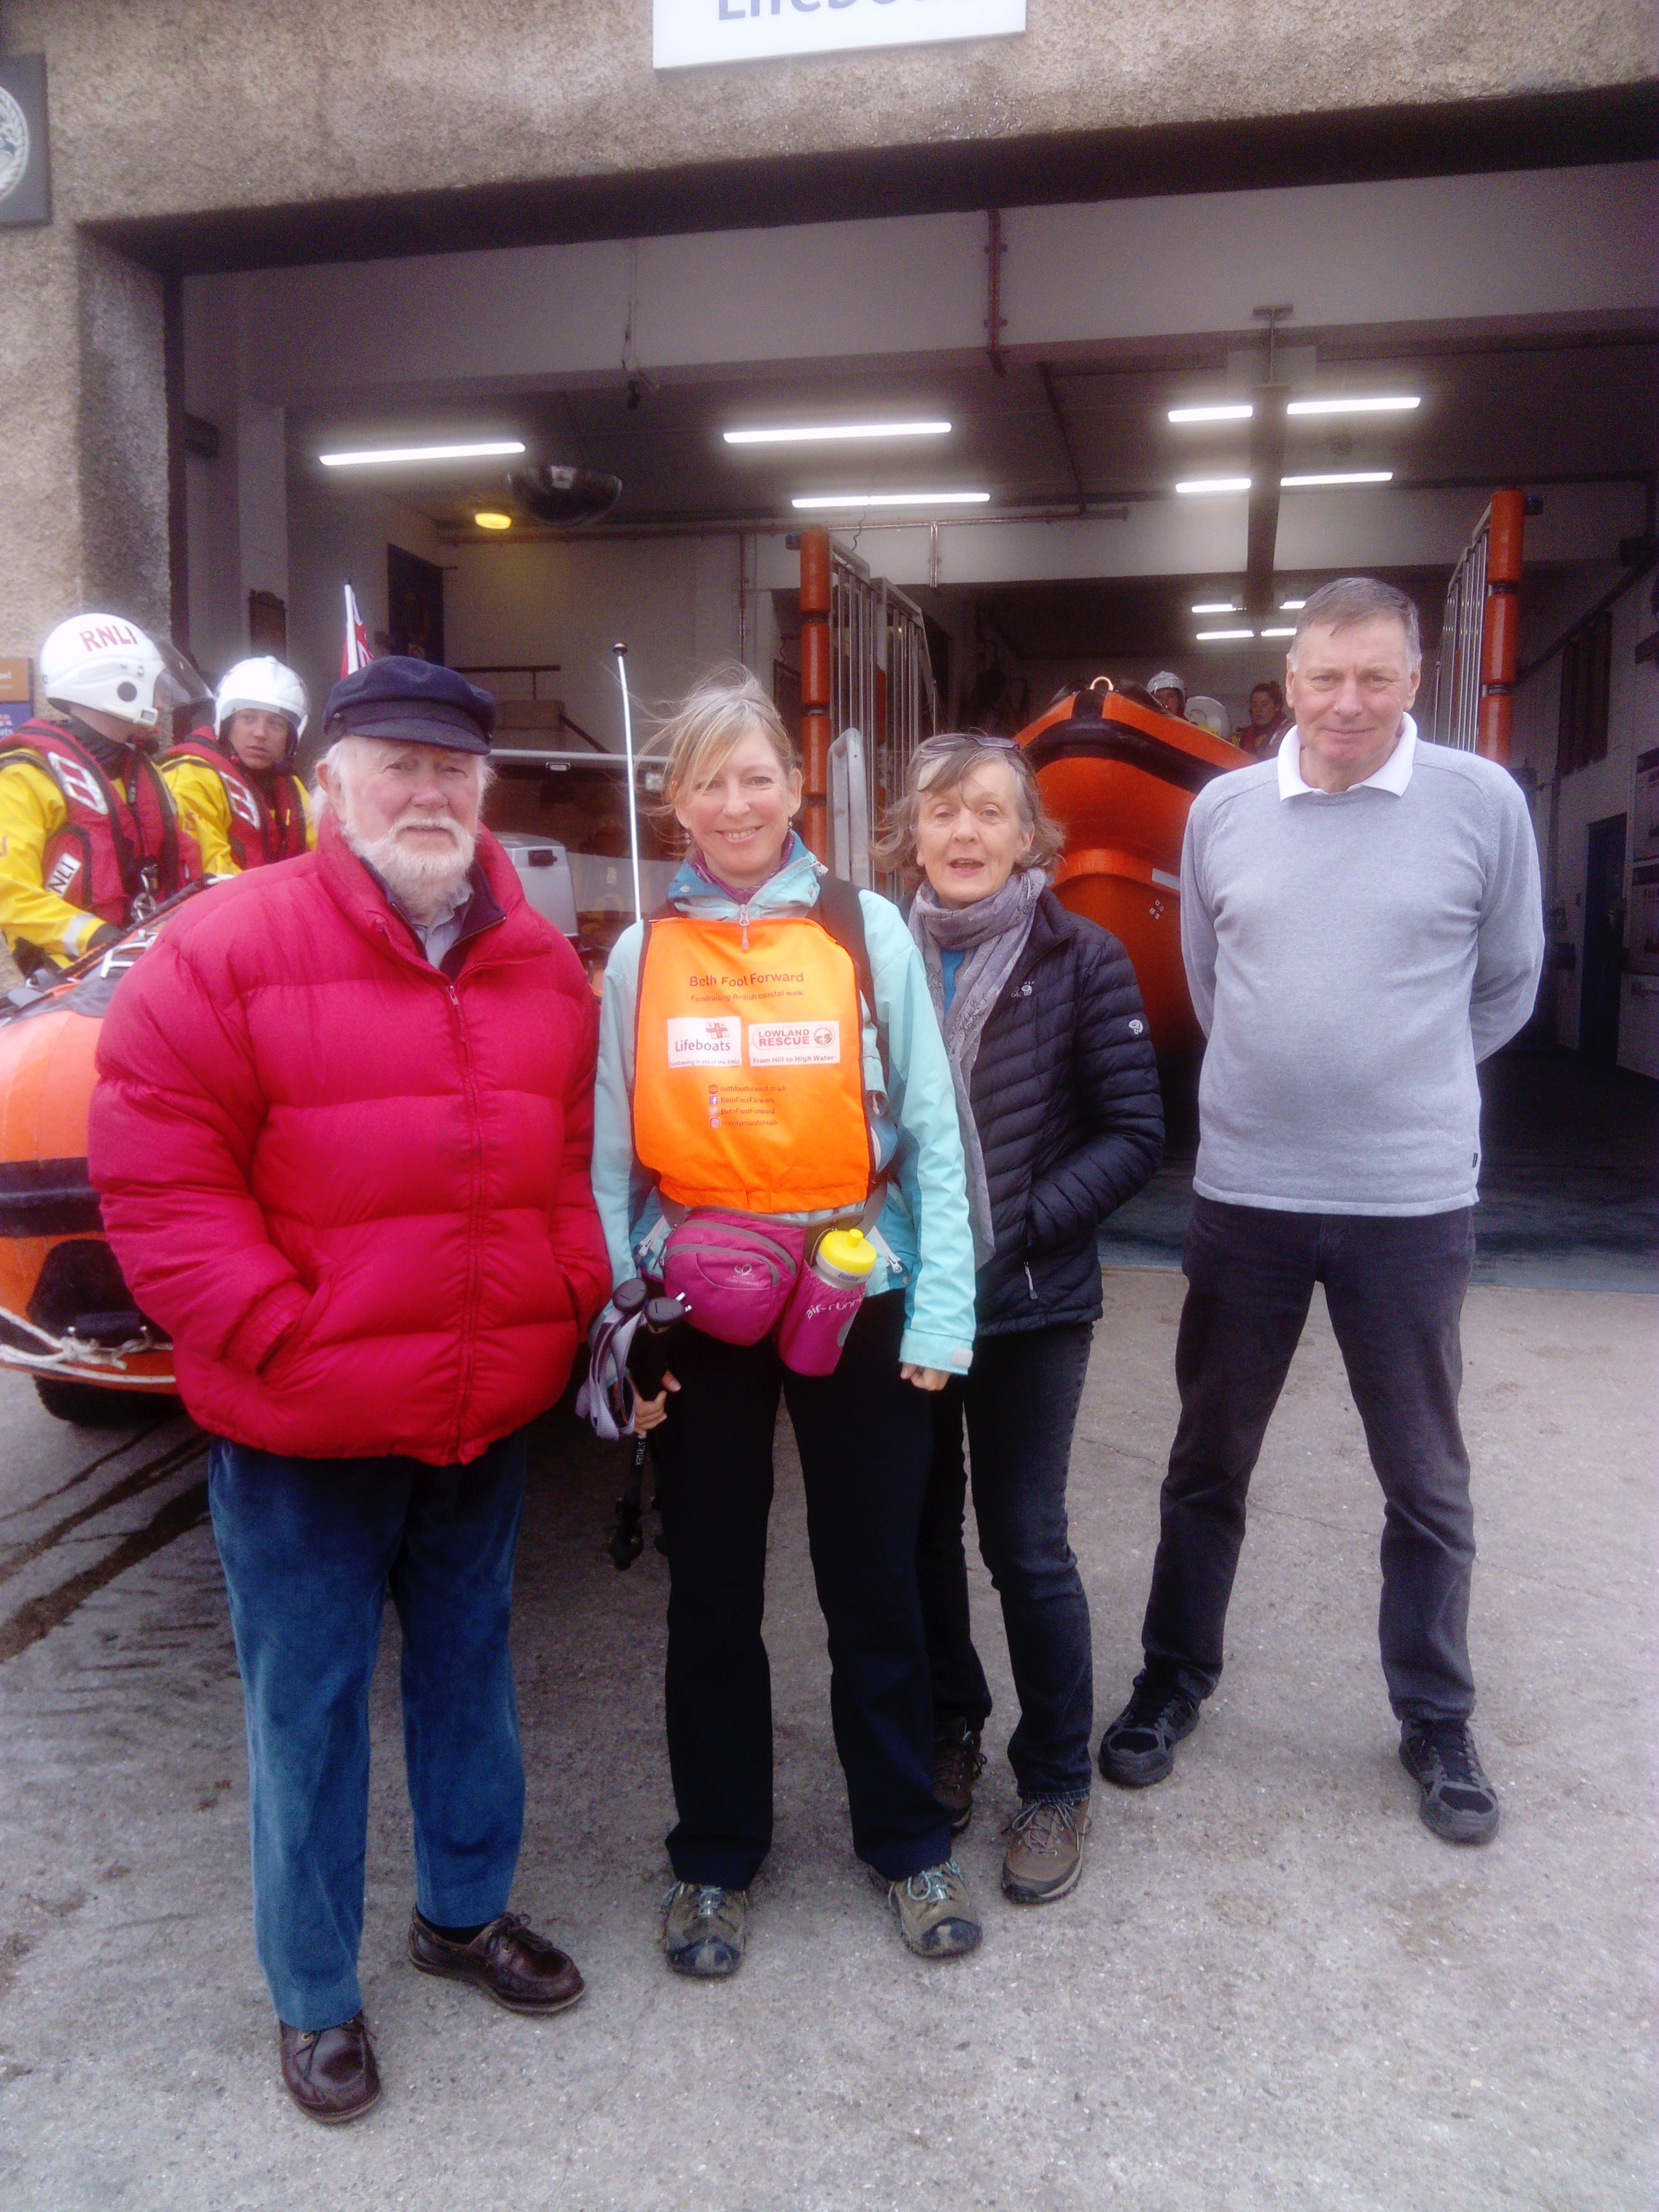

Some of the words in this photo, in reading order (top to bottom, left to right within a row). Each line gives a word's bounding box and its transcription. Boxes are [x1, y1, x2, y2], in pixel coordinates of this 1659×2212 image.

[80, 625, 138, 652] RNLI
[49, 861, 74, 894] NLI
[690, 975, 716, 986] Beth
[722, 976, 748, 986] Foot
[750, 973, 803, 984] Forward
[759, 1029, 809, 1037] LOWLAND
[675, 1039, 731, 1052] Lifeboats
[759, 1037, 810, 1046] RESCUE
